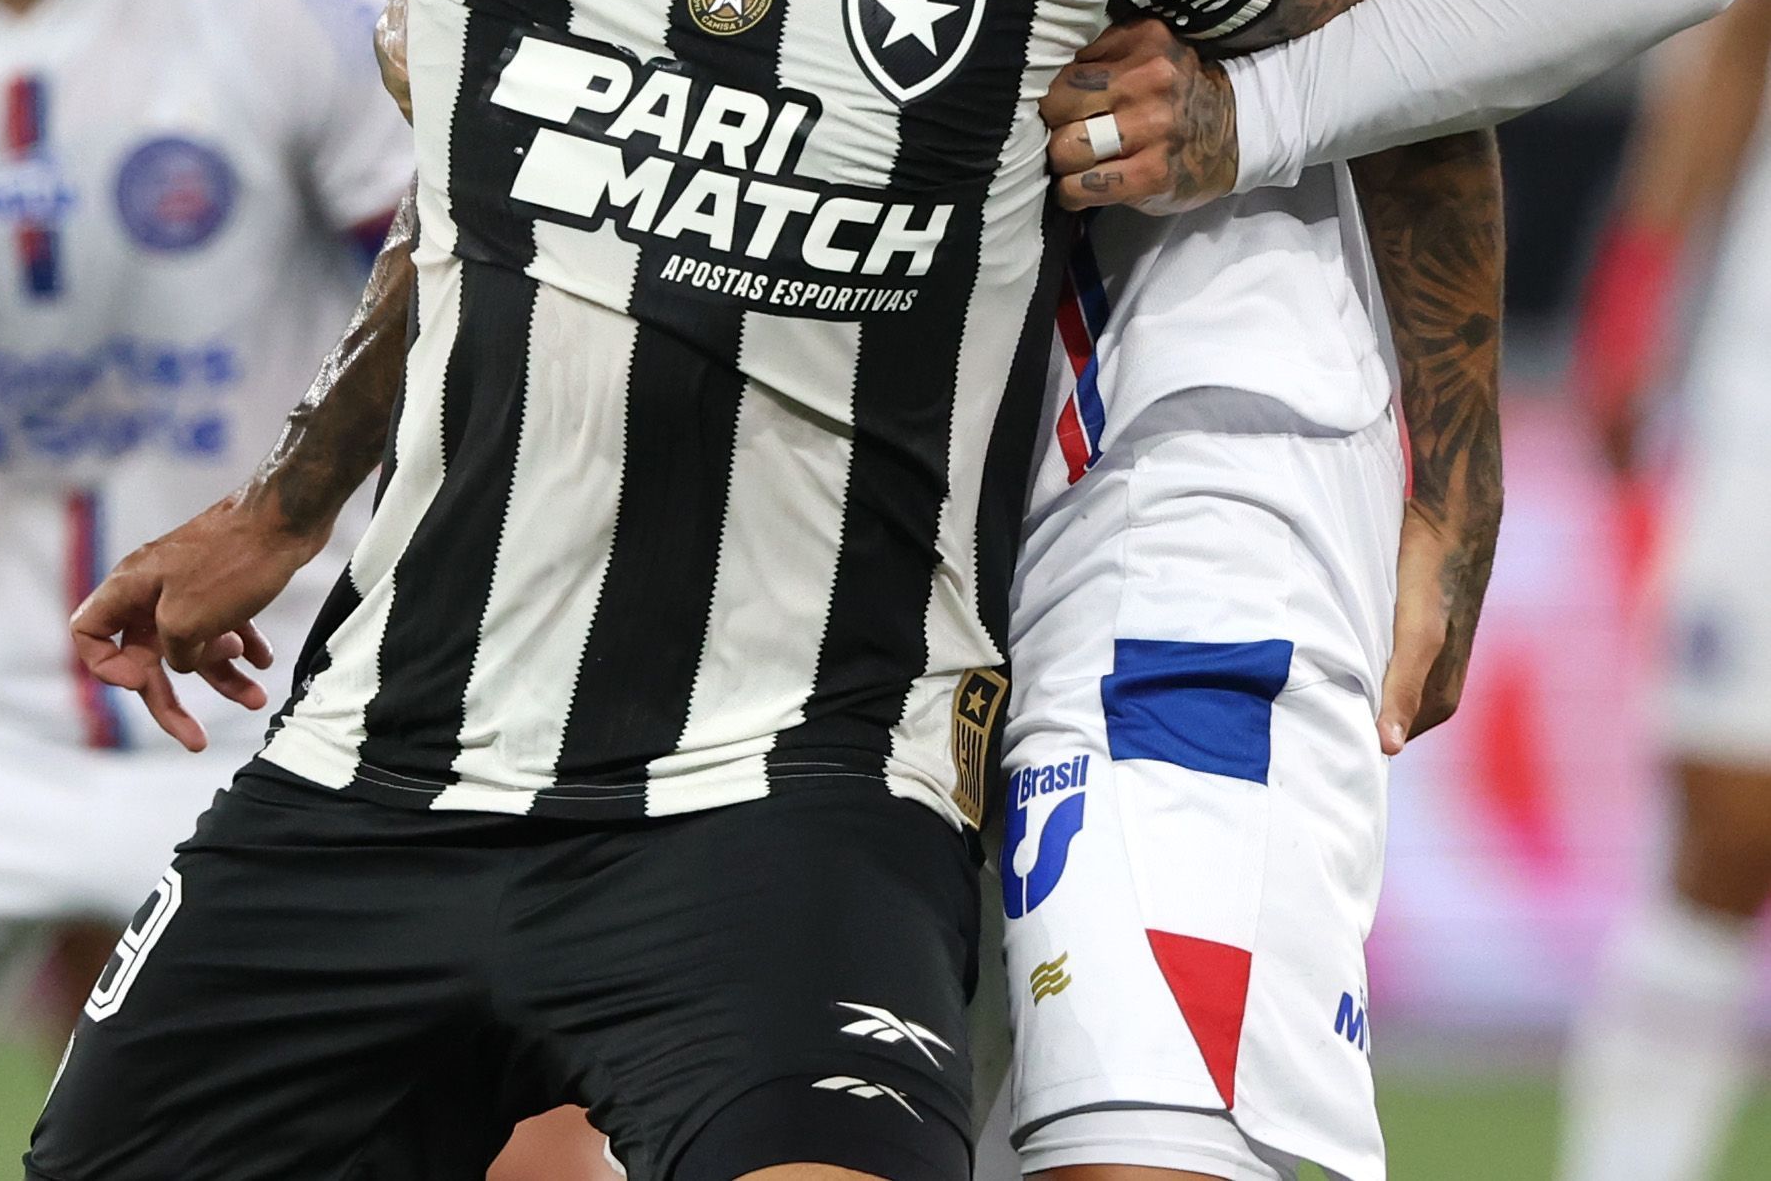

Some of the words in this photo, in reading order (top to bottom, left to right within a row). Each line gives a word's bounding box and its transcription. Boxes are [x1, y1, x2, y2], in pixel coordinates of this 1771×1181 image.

[701, 15, 737, 31] CAMISA
[490, 35, 809, 177] PARI
[509, 127, 955, 277] MATCH
[660, 254, 769, 301] APOSTAS
[769, 278, 919, 312] ESPORTIVAS
[1020, 754, 1090, 804] Brasil
